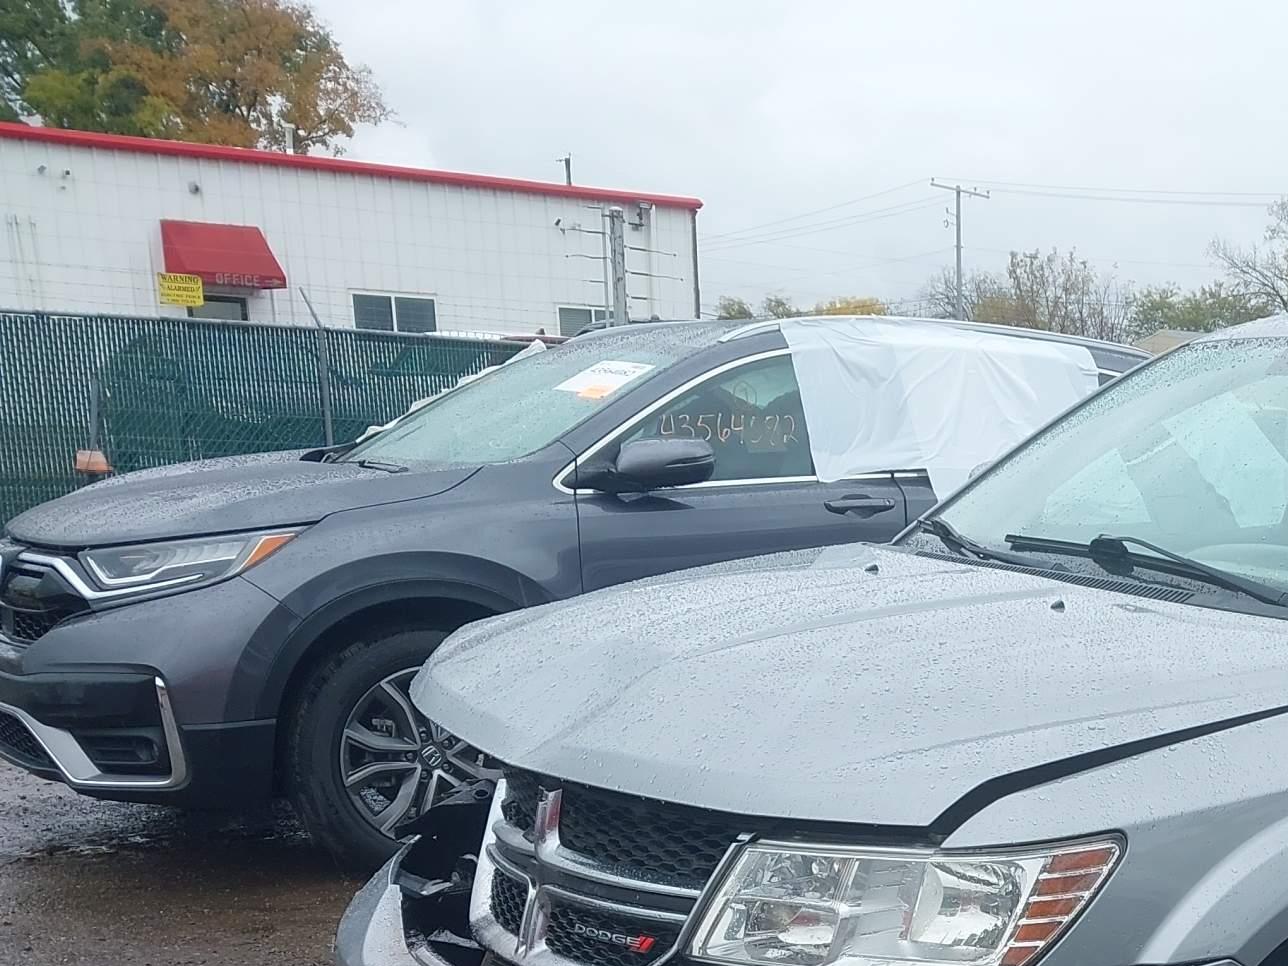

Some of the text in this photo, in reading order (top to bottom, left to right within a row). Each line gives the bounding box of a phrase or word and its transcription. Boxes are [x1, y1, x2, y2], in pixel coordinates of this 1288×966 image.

[160, 274, 198, 284] WARNING
[215, 273, 261, 287] OFFICE
[574, 923, 641, 948] DODGE
